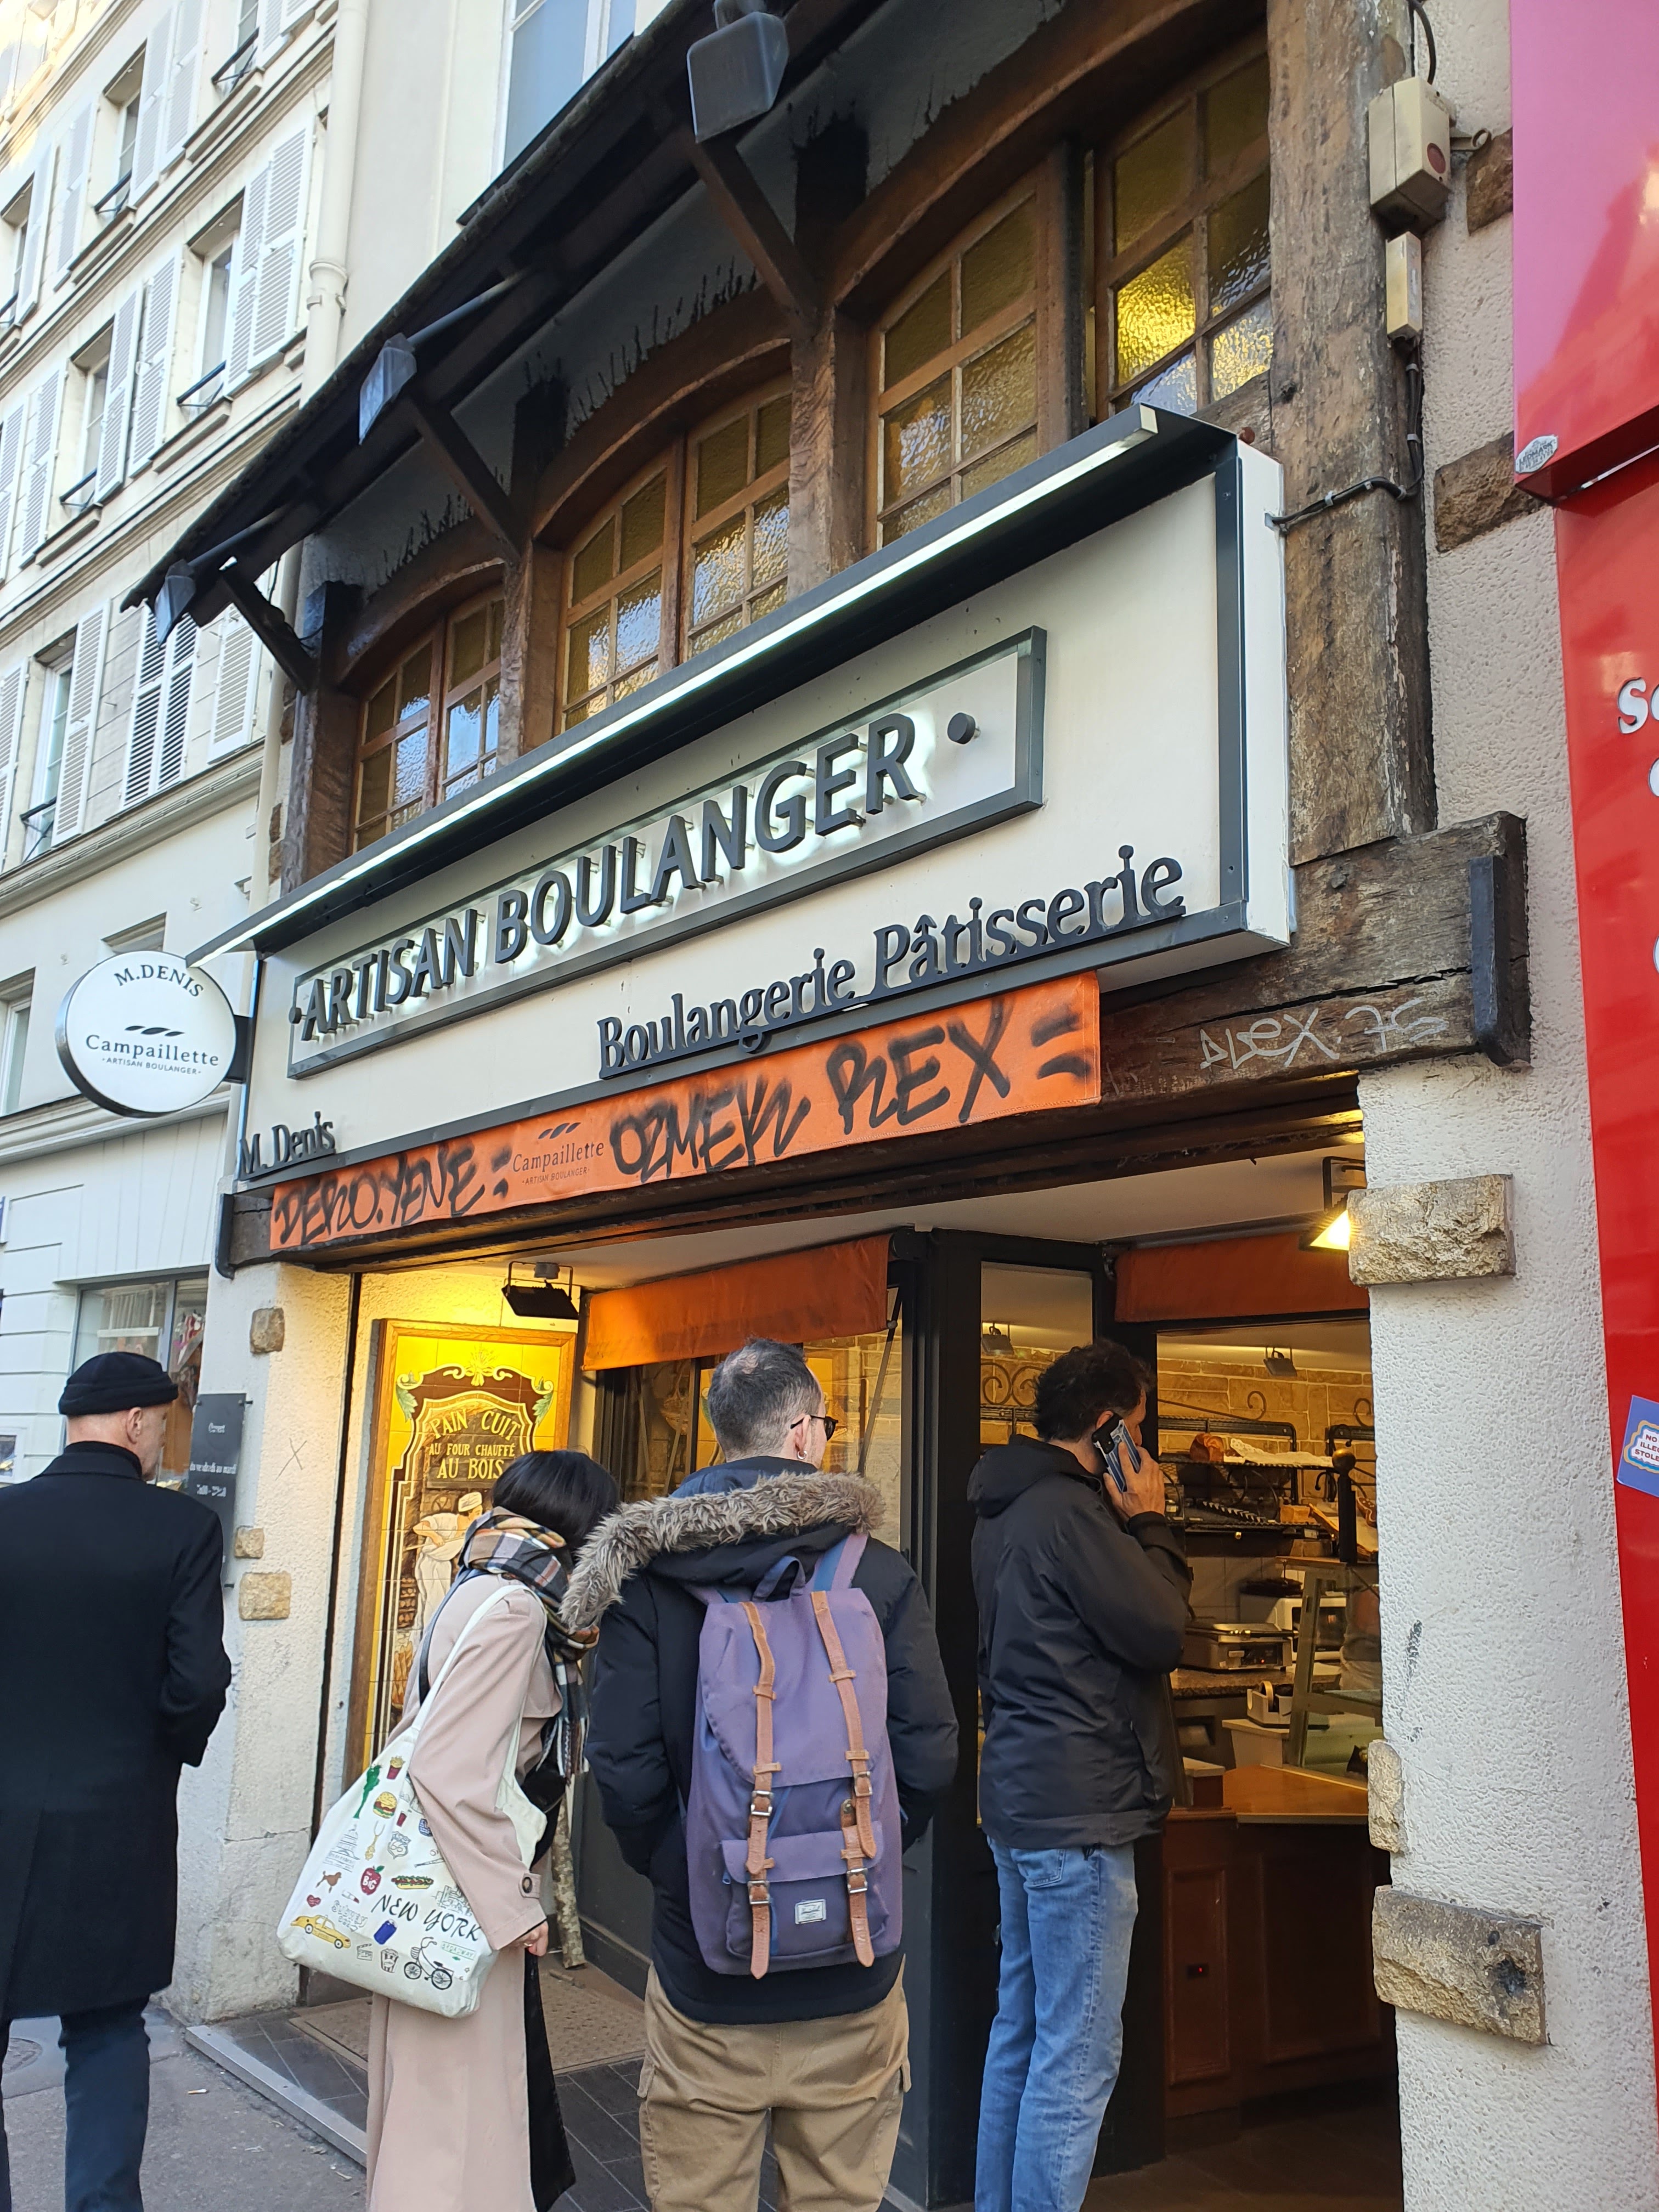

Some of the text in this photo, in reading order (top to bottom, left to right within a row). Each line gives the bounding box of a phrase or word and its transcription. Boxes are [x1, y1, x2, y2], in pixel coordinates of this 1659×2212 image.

[302, 712, 921, 1041] ARTISAN BOULANGER
[597, 844, 1186, 1080] Boulangerie Pâtisserie
[114, 964, 204, 997] M.DENIS
[86, 1034, 219, 1066] Campaillette
[106, 1057, 198, 1075] ARTISAN BOULANGER
[239, 1110, 336, 1181] M. Denis
[512, 1142, 604, 1172] Campaillette
[525, 1166, 588, 1185] ARTISAN BOULANGER
[430, 1408, 521, 1441] PAIN CUIT
[1646, 1434, 1657, 1443] NO
[429, 1443, 516, 1457] AU FOUR CHAUFFÉ
[437, 1458, 504, 1480] AU BOIS
[371, 1894, 419, 1922] NEW
[423, 1909, 482, 1942] YORK
